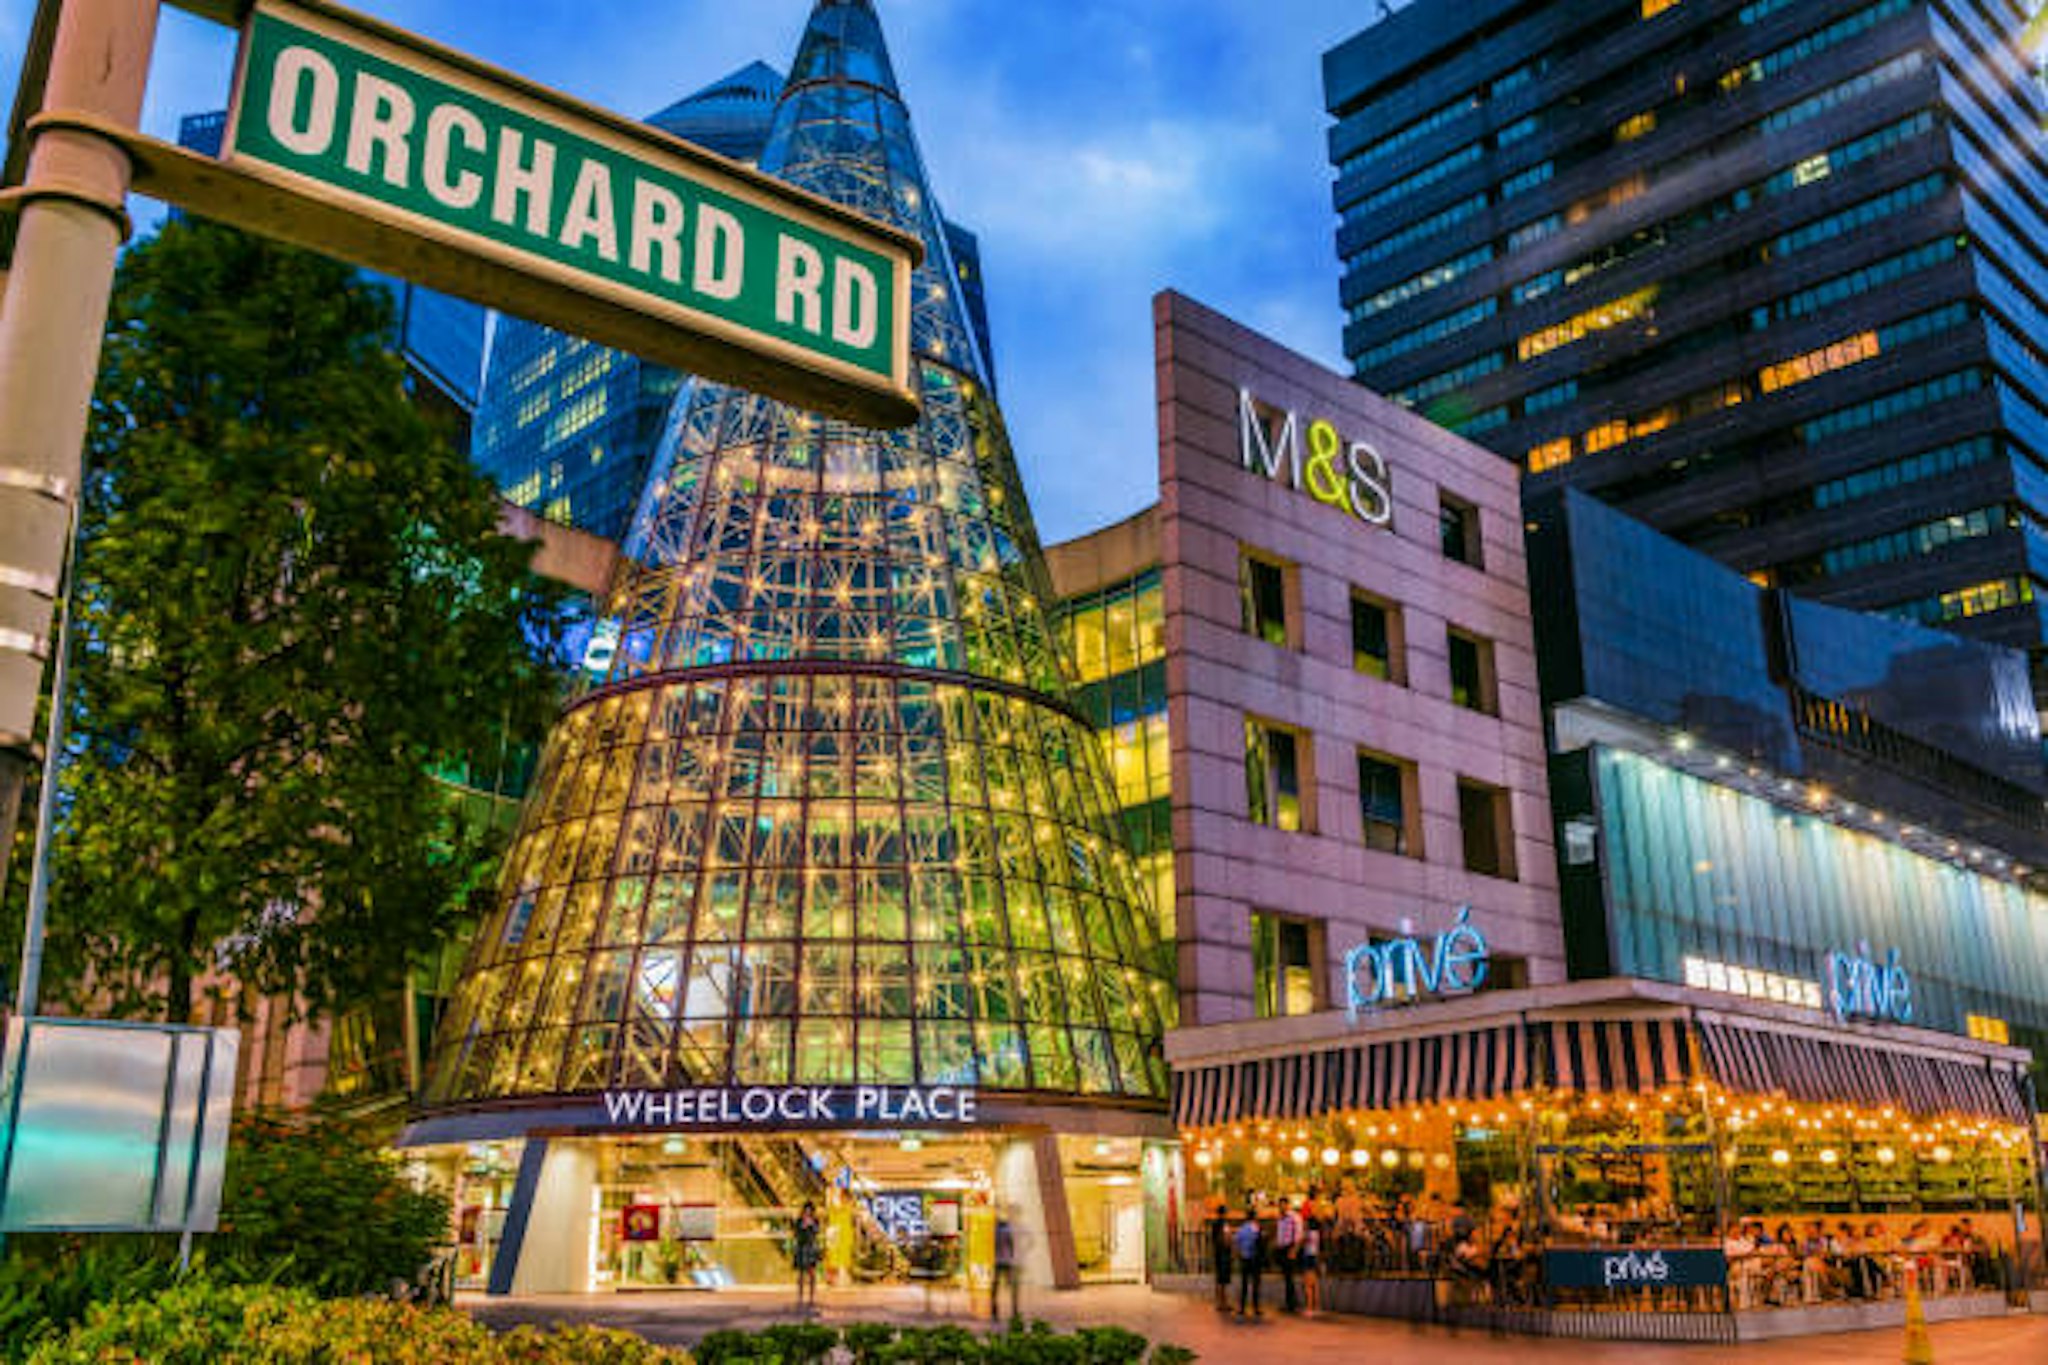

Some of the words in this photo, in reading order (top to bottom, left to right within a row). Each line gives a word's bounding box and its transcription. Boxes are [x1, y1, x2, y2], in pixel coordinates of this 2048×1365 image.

[267, 46, 745, 300] ORCHARD
[775, 232, 878, 350] RD
[1240, 386, 1391, 524] M&S
[1345, 903, 1487, 1025] privé
[604, 1087, 836, 1125] WHEELOCK
[855, 1086, 977, 1123] PLACE
